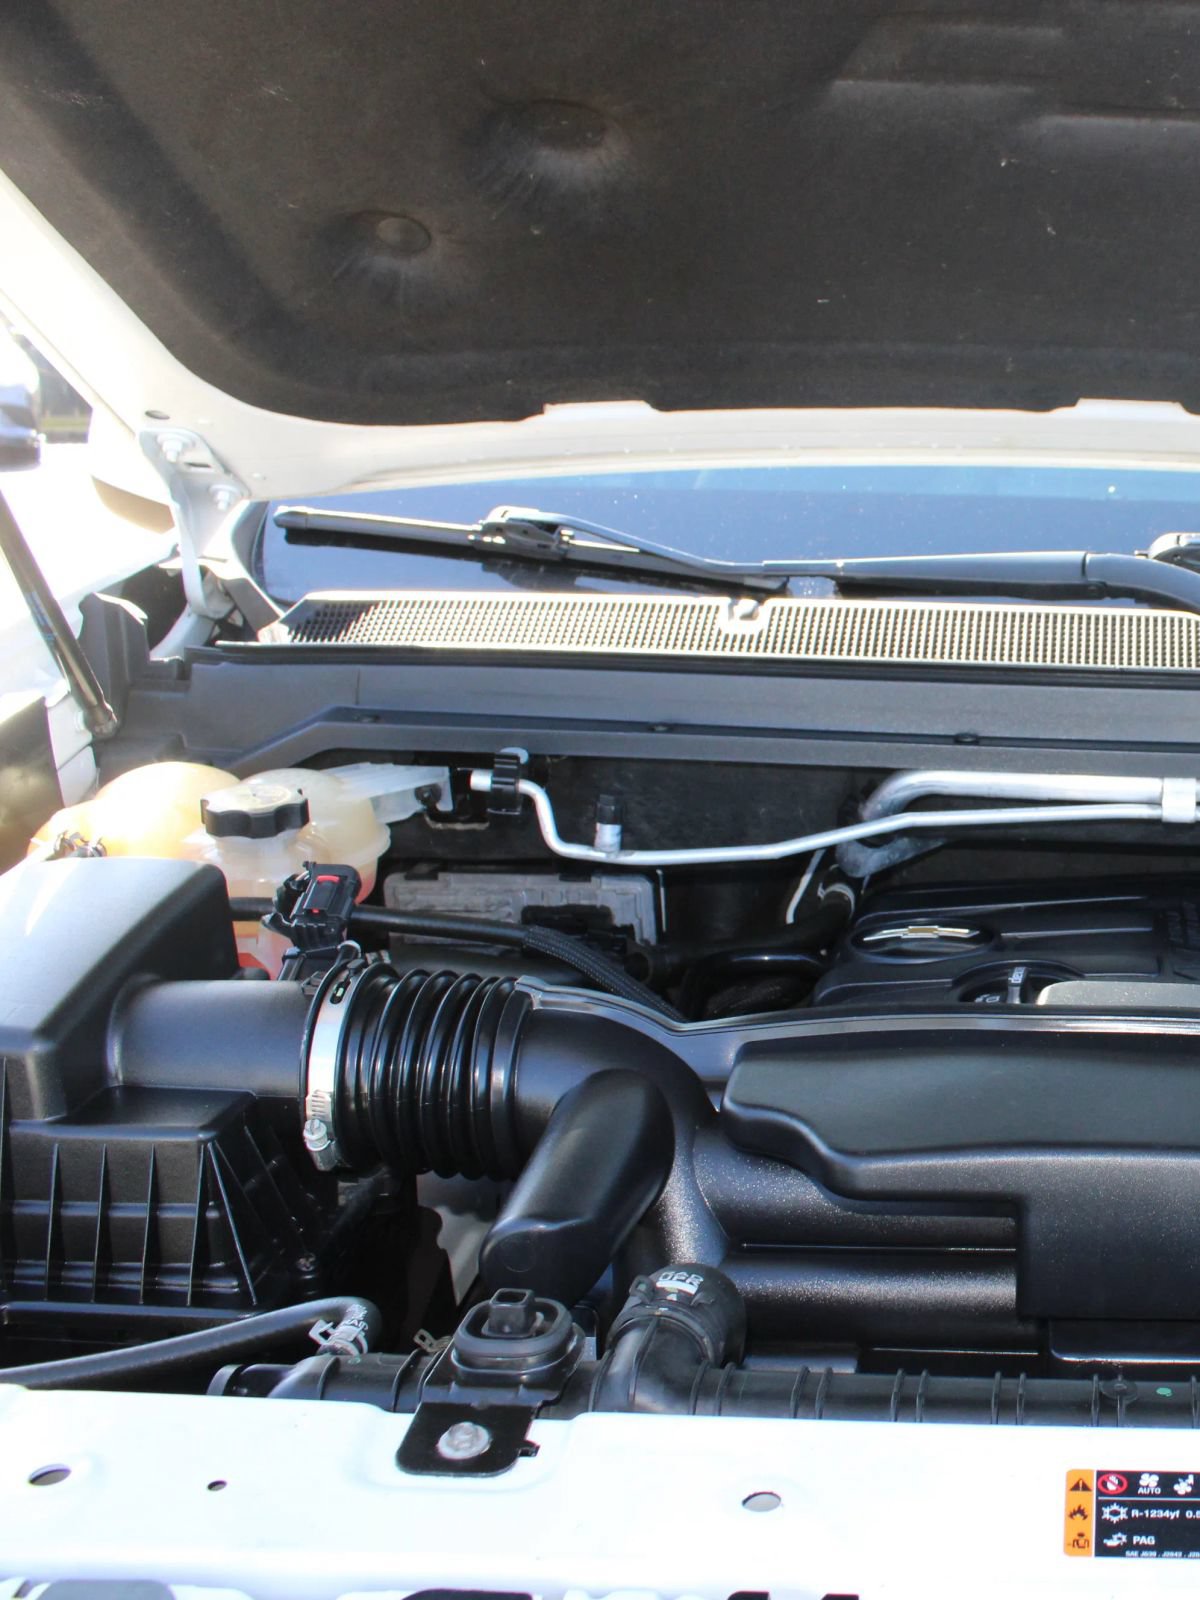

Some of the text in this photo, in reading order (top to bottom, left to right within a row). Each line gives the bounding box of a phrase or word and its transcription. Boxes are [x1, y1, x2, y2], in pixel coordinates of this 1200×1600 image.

[1138, 1487, 1161, 1495] AUTO
[1131, 1509, 1180, 1520] R-1234yf
[1133, 1535, 1156, 1545] PAG
